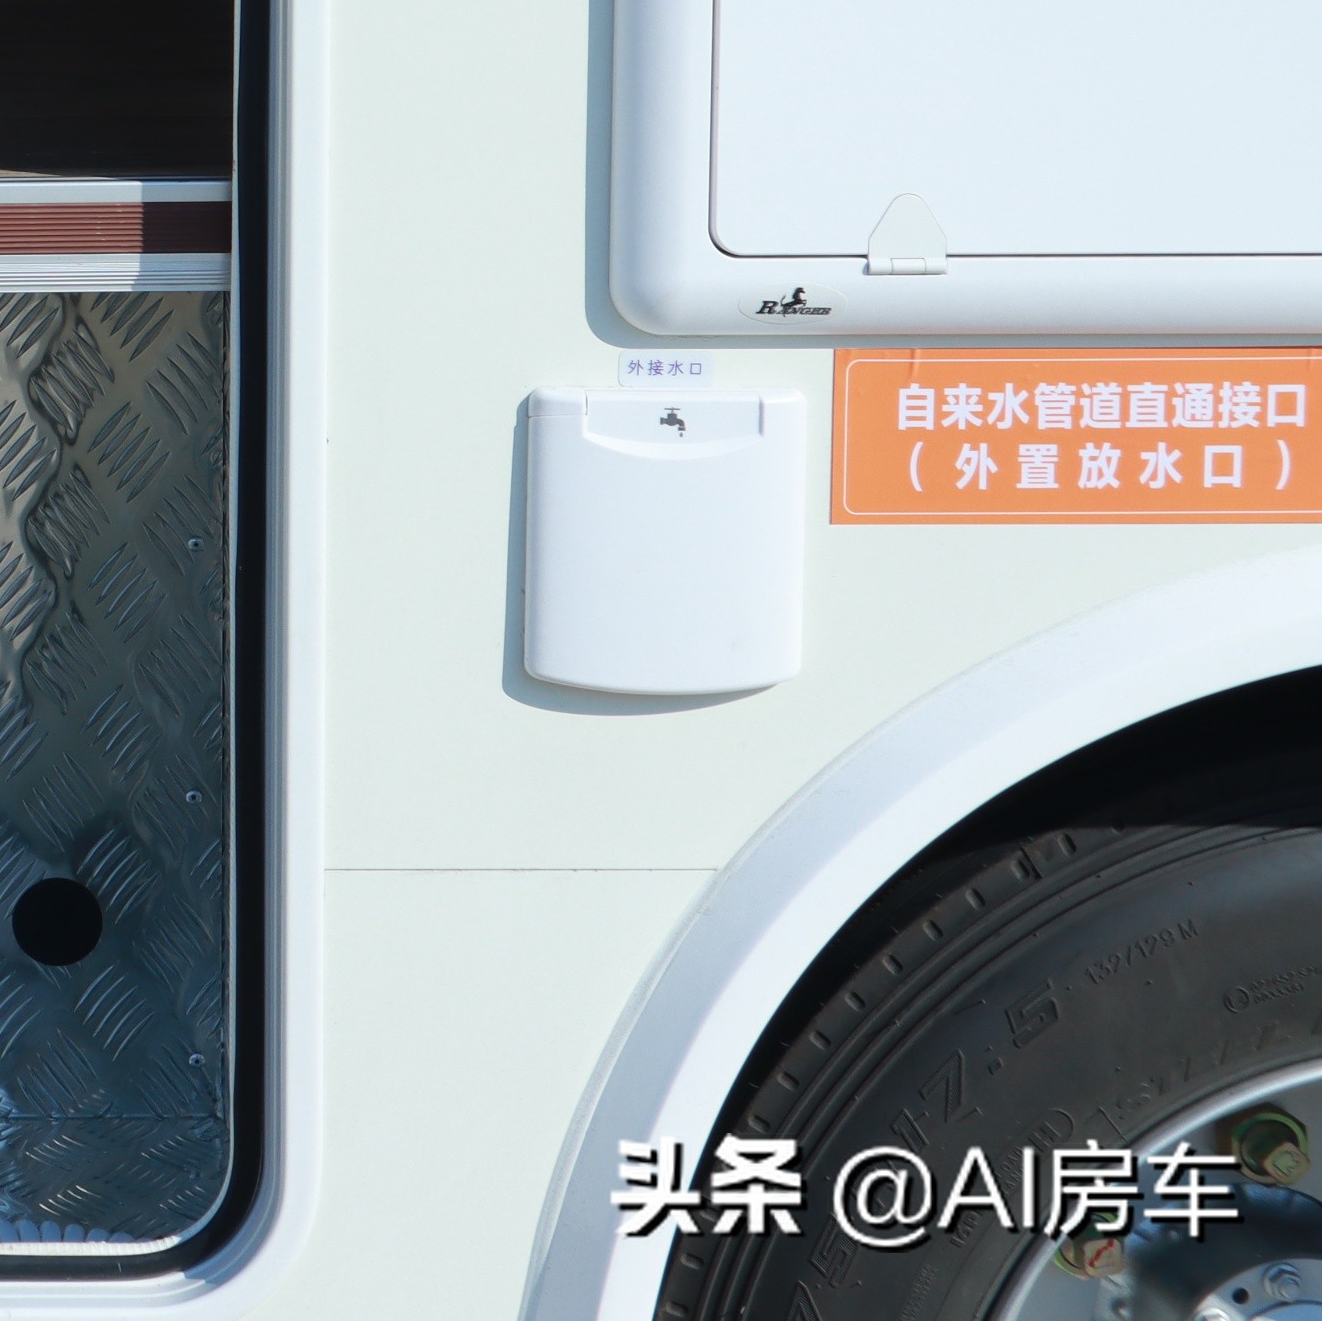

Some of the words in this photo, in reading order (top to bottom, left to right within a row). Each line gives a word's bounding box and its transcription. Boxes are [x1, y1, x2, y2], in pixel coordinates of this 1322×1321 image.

[628, 359, 702, 376] 外接水口
[896, 382, 1306, 431] 自来水管道直通接口
